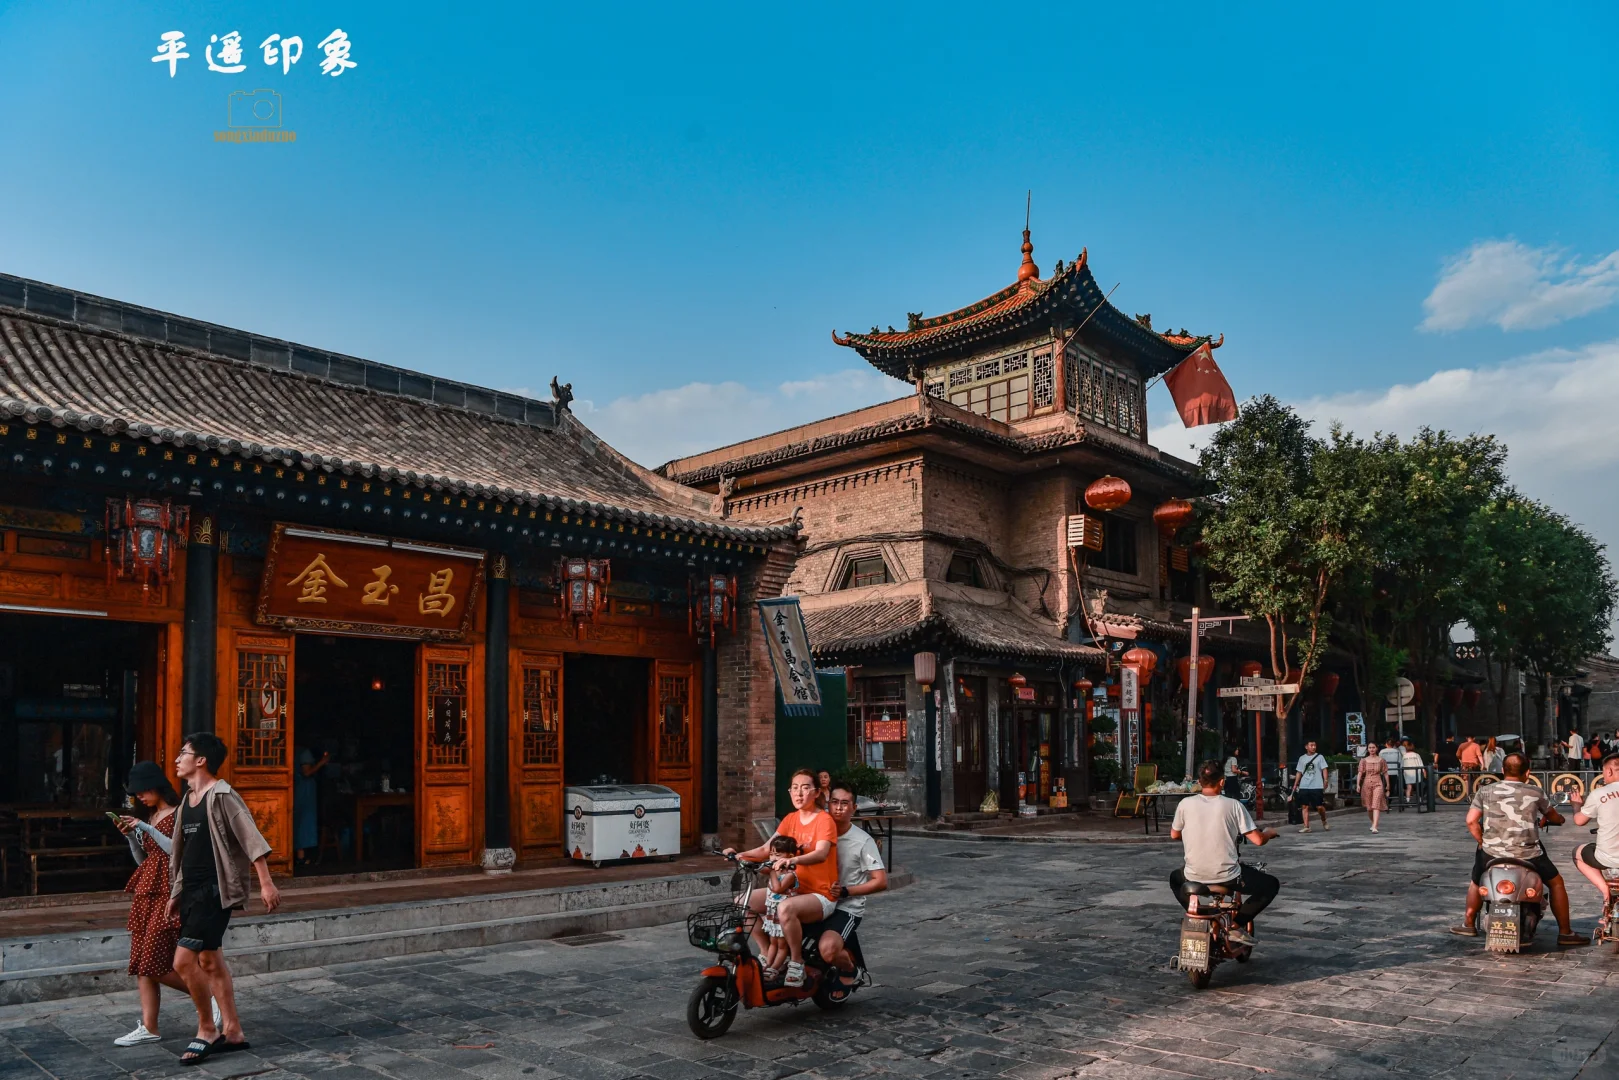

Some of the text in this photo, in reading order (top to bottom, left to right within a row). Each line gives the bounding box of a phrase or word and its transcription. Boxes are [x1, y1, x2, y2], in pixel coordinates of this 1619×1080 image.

[287, 553, 455, 617] 金玉昌
[630, 820, 650, 829] 好阿婆
[1491, 921, 1517, 931] 立马
